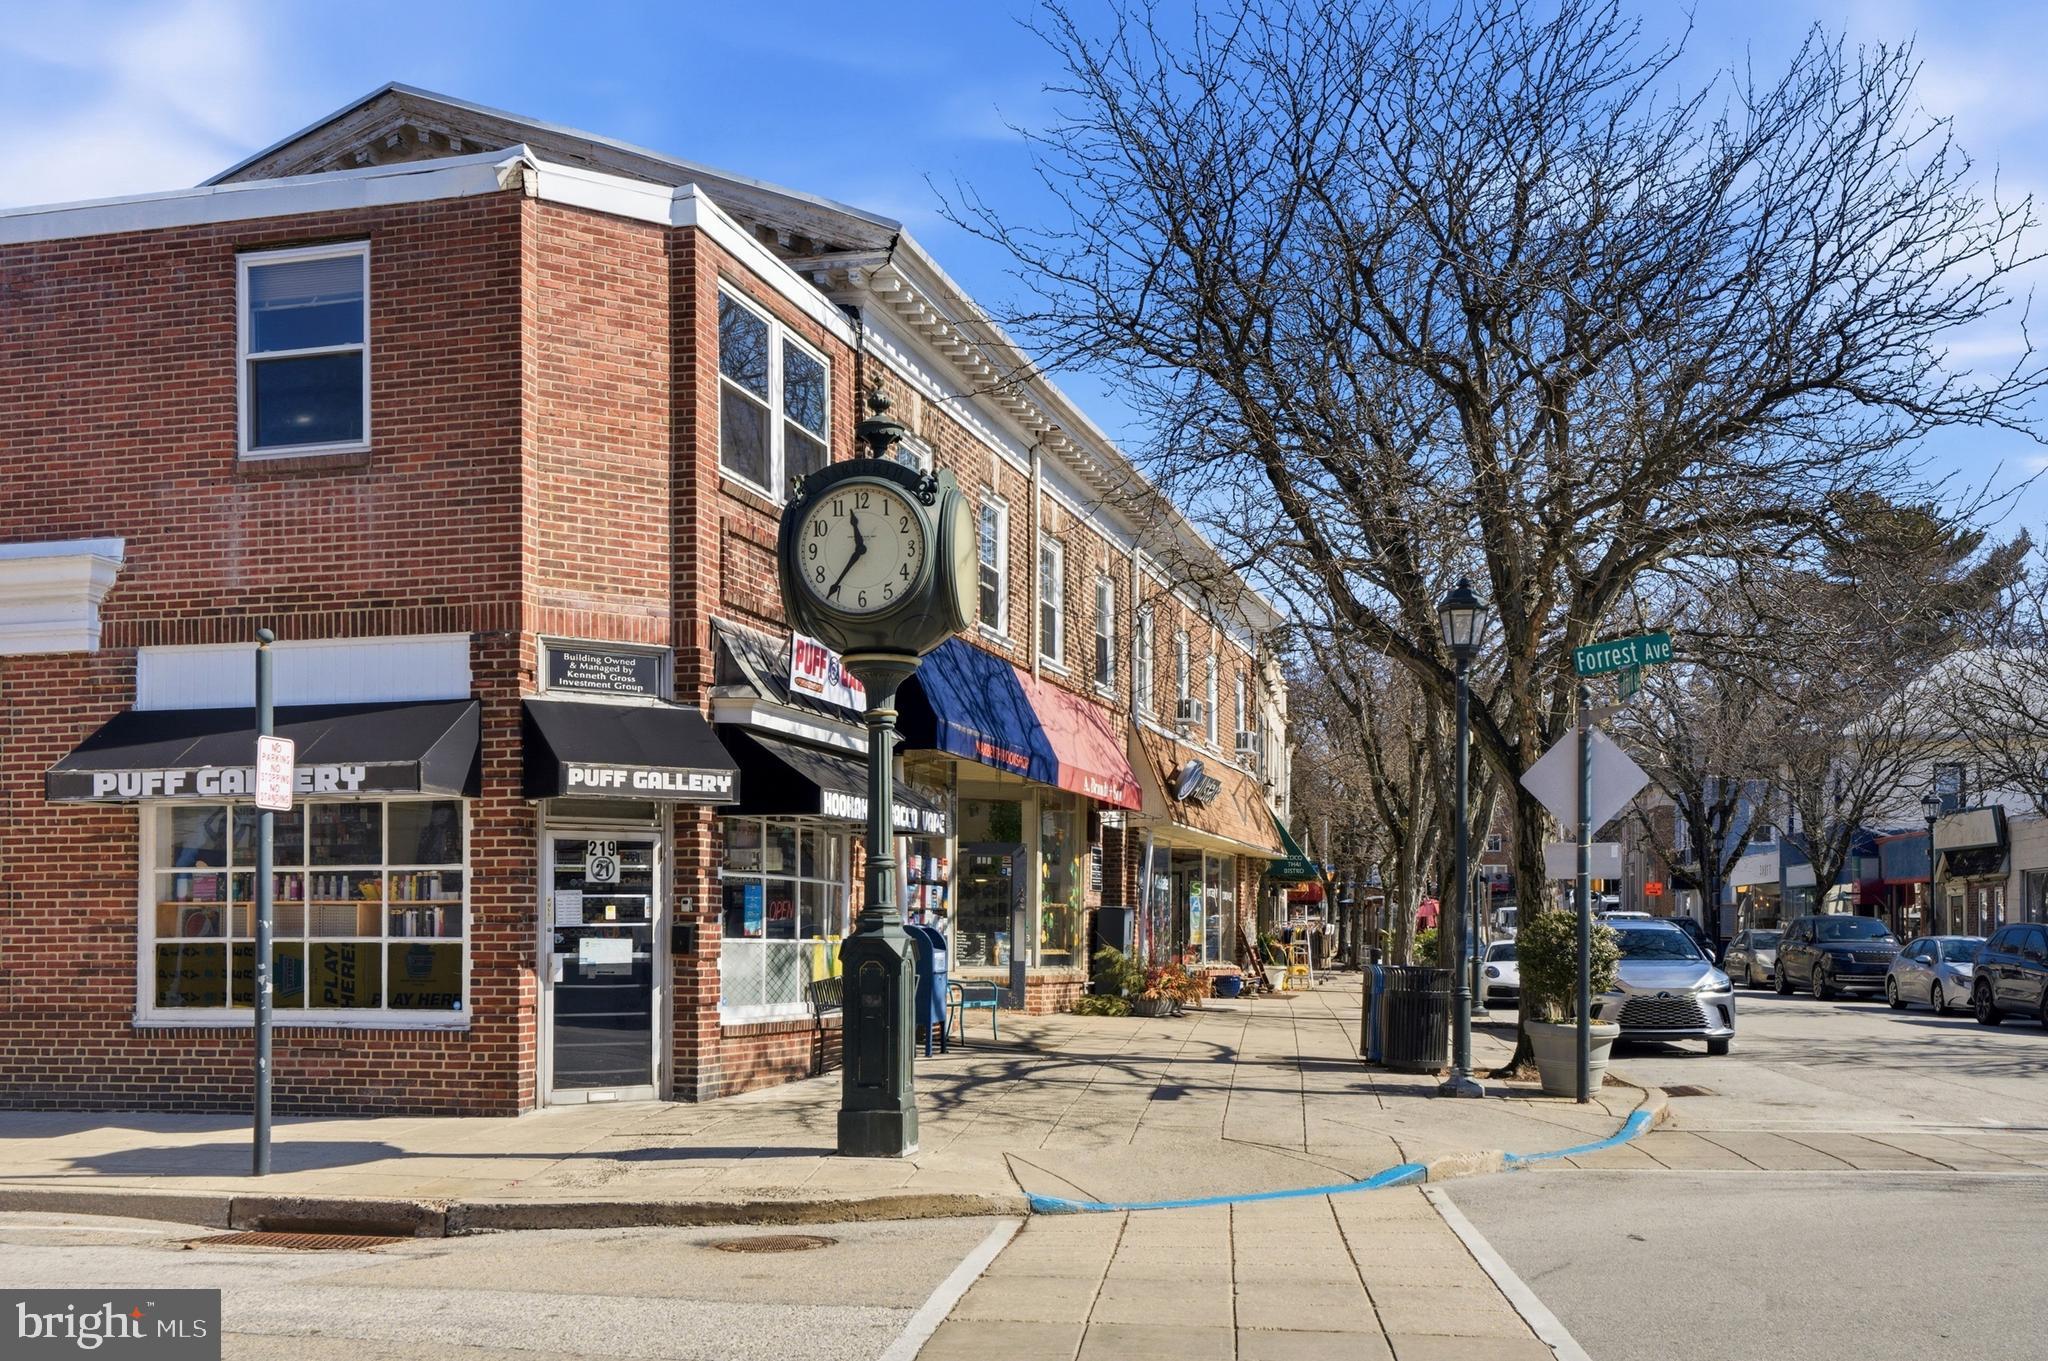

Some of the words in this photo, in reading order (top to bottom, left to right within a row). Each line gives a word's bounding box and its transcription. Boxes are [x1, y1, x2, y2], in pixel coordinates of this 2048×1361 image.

[833, 500, 844, 517] 11
[855, 492, 869, 509] 12
[883, 499, 890, 516] 1
[814, 520, 828, 537] 10
[901, 516, 910, 534] 2
[808, 543, 818, 560] 9
[907, 540, 916, 557] 3
[815, 566, 826, 583] 8
[900, 563, 910, 581] 4
[858, 591, 867, 608] 6
[883, 582, 894, 600] 5
[563, 652, 602, 665] Building
[604, 656, 636, 666] Owned
[795, 638, 828, 679] PUFF
[1577, 641, 1638, 672] Forrest
[1645, 642, 1670, 660] Ave
[567, 670, 606, 680] Kenneth
[609, 673, 636, 683] Gross
[579, 662, 620, 674] Managed
[622, 666, 634, 675] by
[559, 677, 611, 689] Investment
[614, 682, 644, 692] Group
[271, 742, 282, 753] NO
[261, 752, 290, 765] PARKING
[271, 764, 280, 773] NO
[93, 771, 187, 797] PUFF
[196, 766, 366, 795] GALERY
[270, 783, 280, 793] NO
[568, 768, 628, 788] PUFF
[633, 771, 732, 793] GALLERY
[922, 810, 945, 834] VAPE
[589, 841, 616, 856] 219
[596, 863, 609, 877] 21
[769, 901, 794, 921] OPEN
